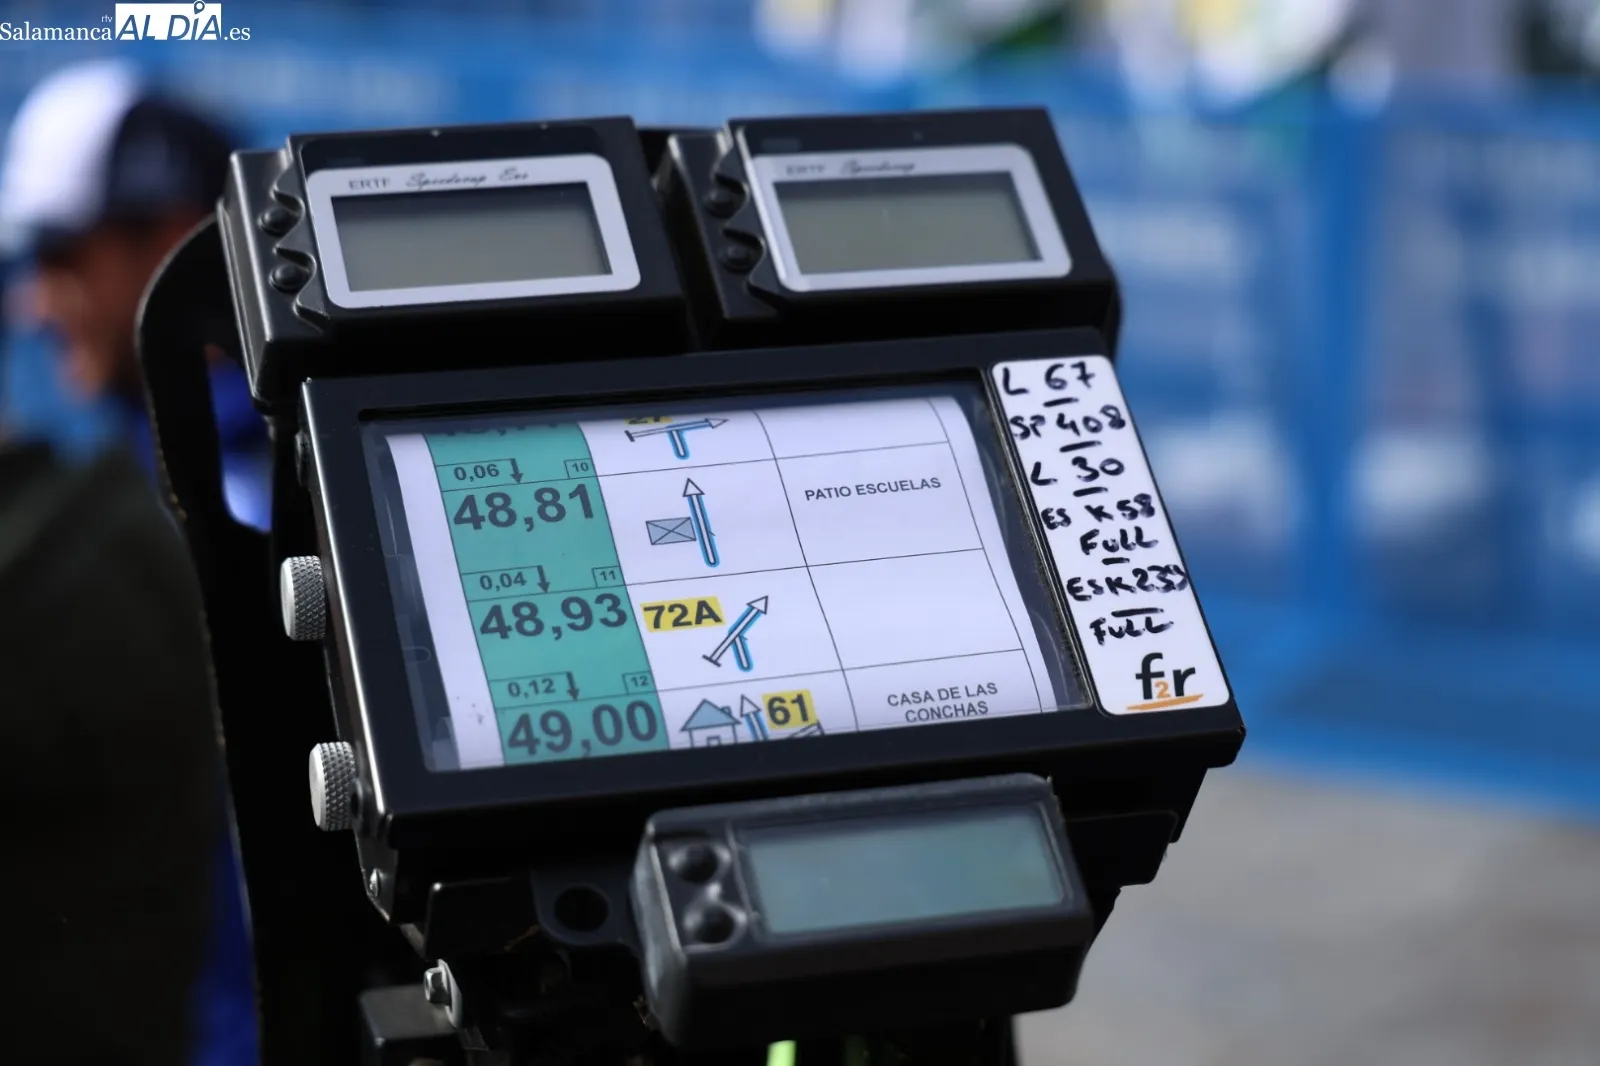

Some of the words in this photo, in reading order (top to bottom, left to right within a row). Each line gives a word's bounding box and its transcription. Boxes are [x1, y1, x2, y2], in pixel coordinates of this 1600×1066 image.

[349, 177, 391, 190] ERTF
[1002, 366, 1030, 396] L
[1044, 361, 1095, 391] 67
[1056, 404, 1126, 437] 408
[453, 462, 500, 482] 0,06
[572, 461, 590, 474] 10
[1030, 461, 1059, 486] L
[1071, 456, 1125, 483] 30
[804, 486, 851, 502] PATIO
[855, 476, 942, 497] ESCUELAS
[453, 483, 595, 532] 48,81
[479, 571, 527, 591] 0,04
[600, 569, 617, 582] 11
[479, 593, 628, 641] 48,93
[643, 600, 722, 630] 72A
[507, 678, 556, 699] 0,12
[630, 675, 648, 688] 12
[887, 692, 935, 707] CASA
[937, 687, 962, 702] DE
[965, 682, 999, 698] LAS
[766, 693, 810, 726] 61
[905, 701, 989, 723] CONCHAS
[507, 700, 659, 757] 49,00
